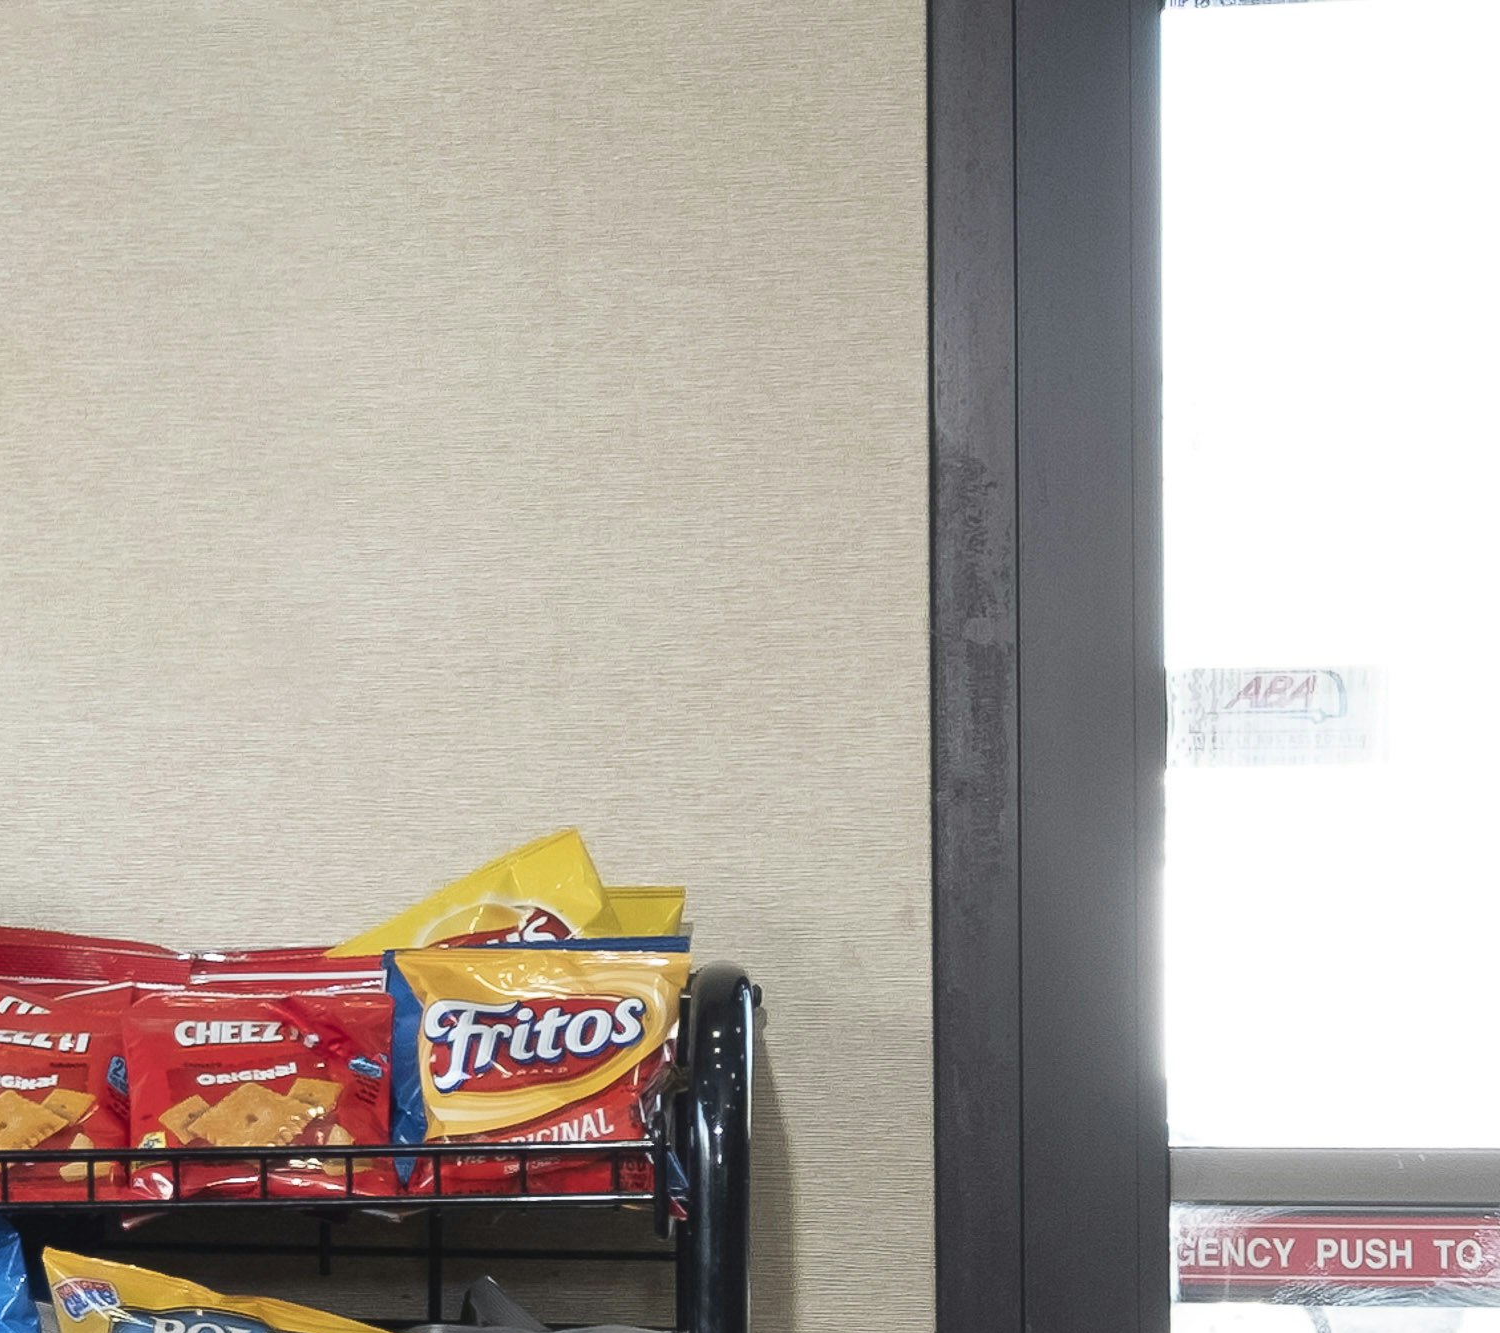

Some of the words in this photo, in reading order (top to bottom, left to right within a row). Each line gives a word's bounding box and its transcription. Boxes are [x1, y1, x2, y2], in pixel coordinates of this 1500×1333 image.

[424, 998, 646, 1094] Fritos
[1317, 1239, 1412, 1269] PUSH
[1434, 1239, 1484, 1270] TO
